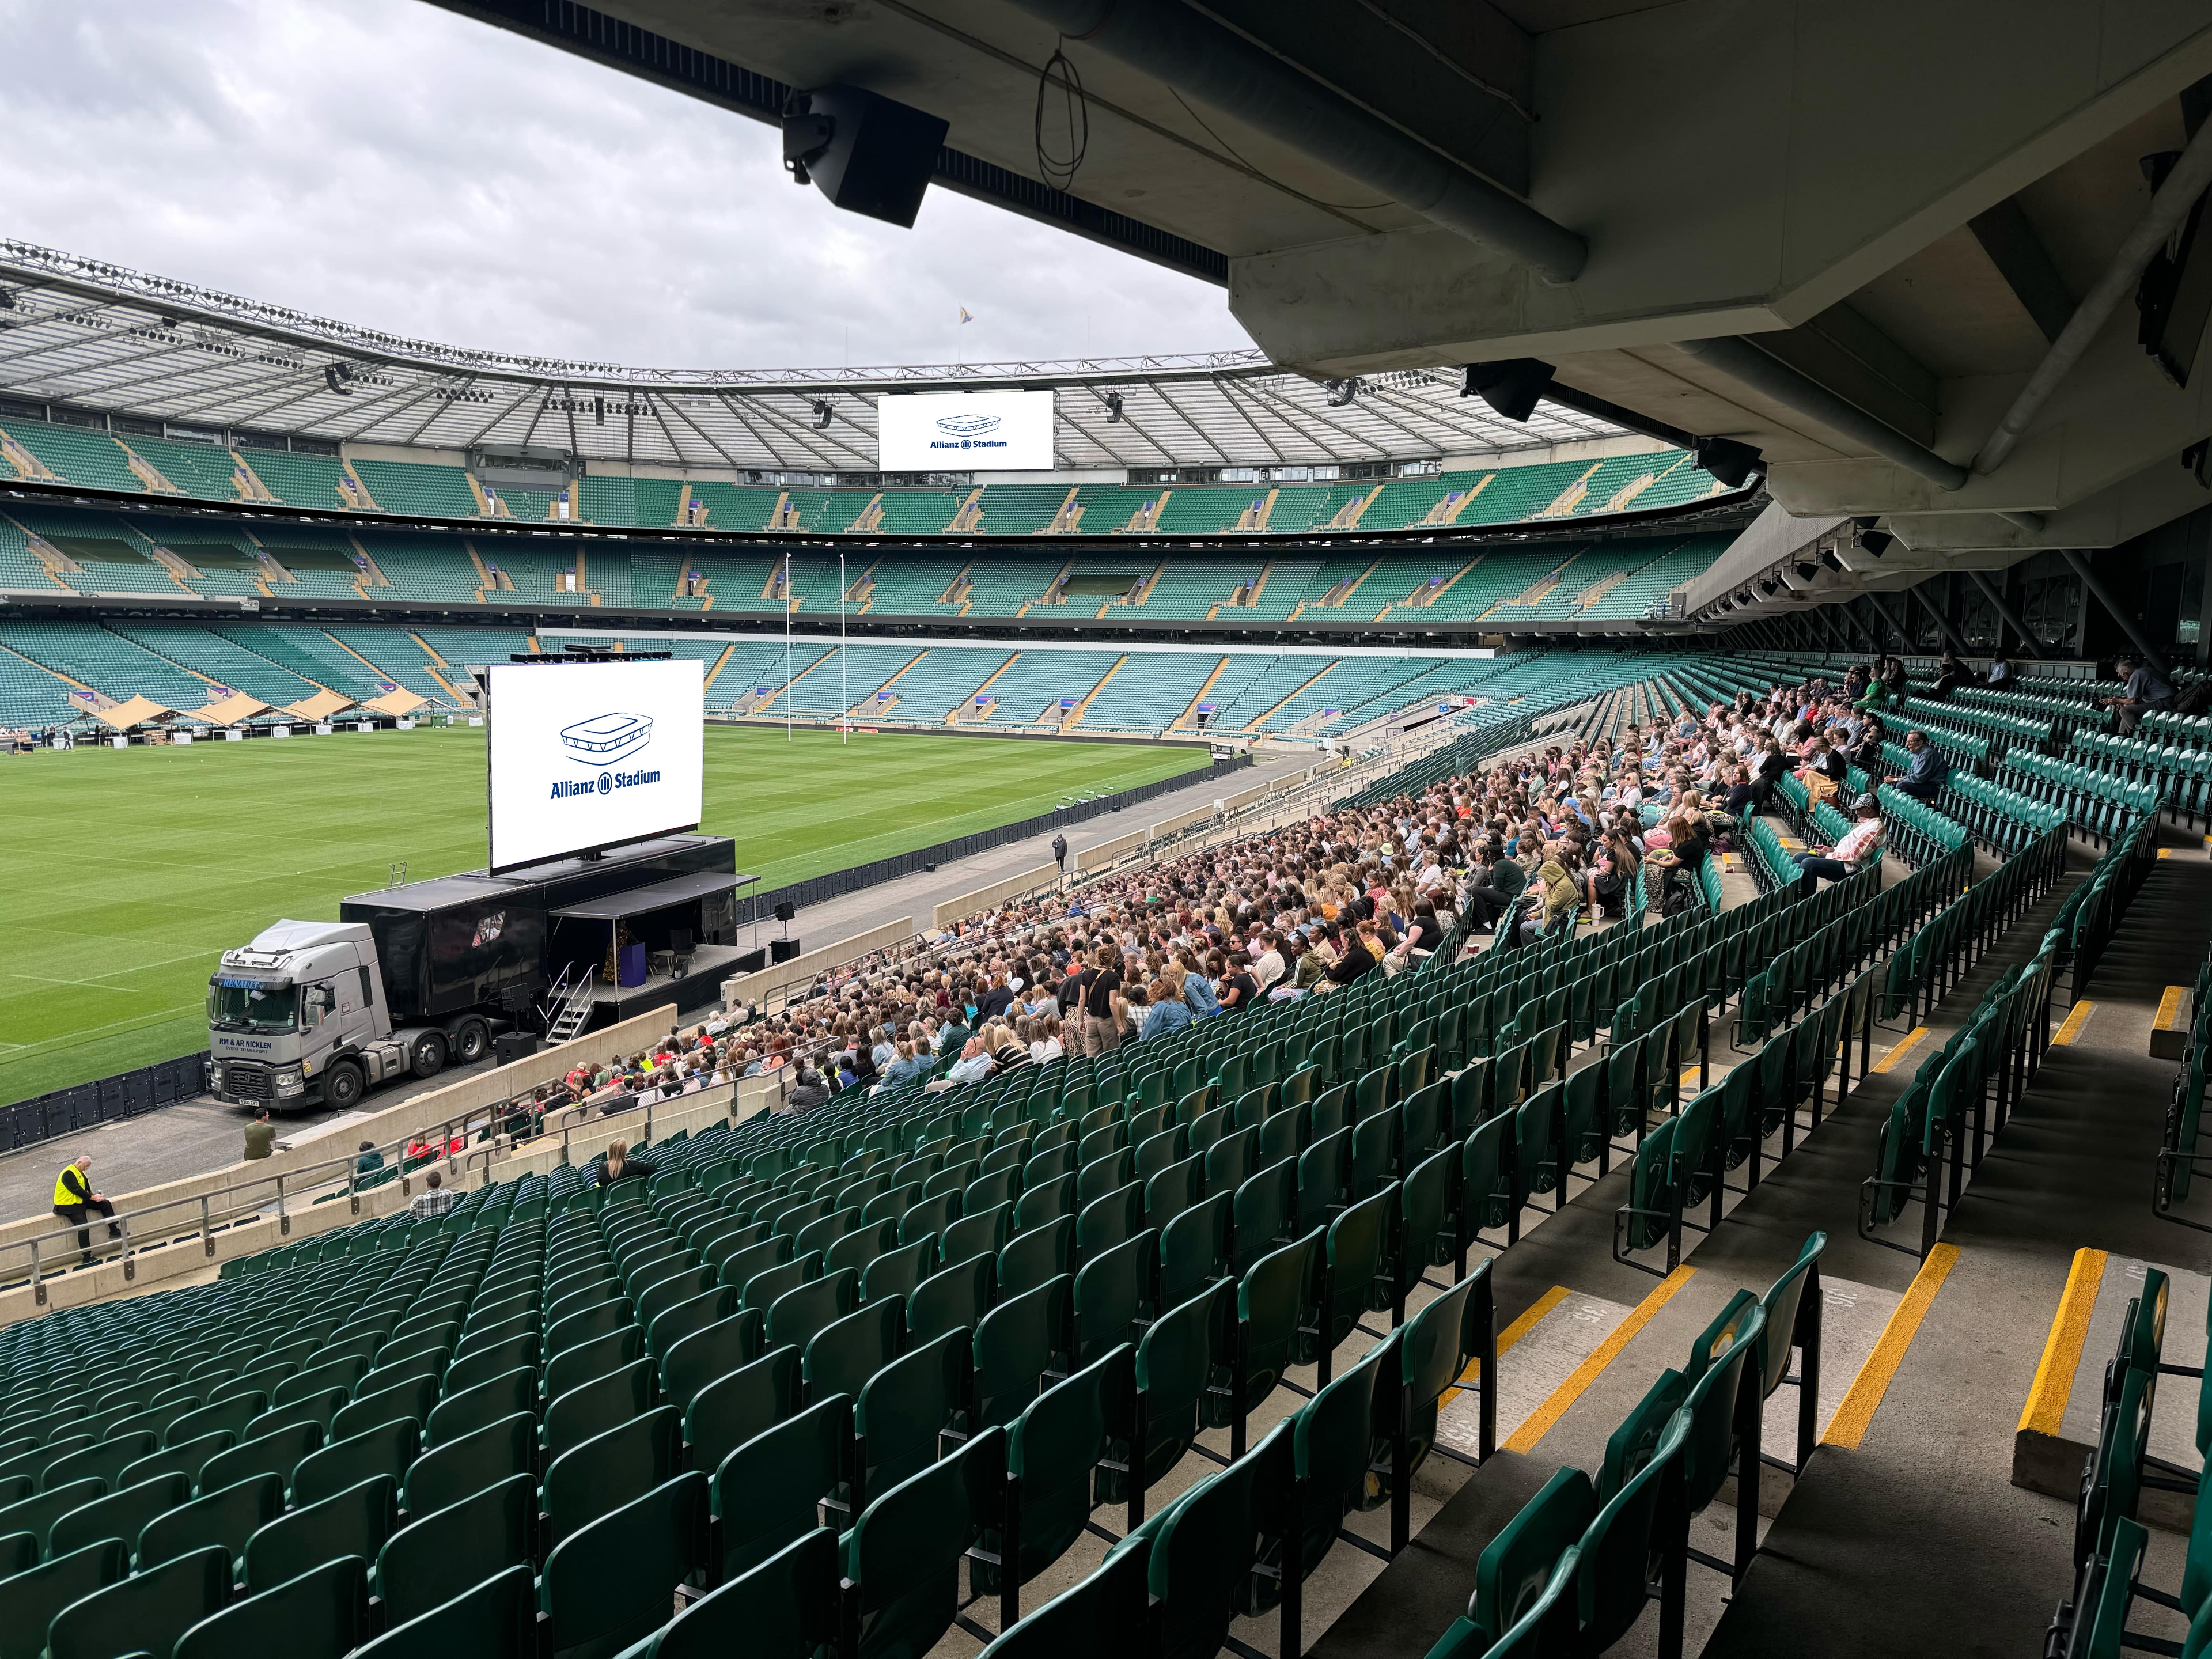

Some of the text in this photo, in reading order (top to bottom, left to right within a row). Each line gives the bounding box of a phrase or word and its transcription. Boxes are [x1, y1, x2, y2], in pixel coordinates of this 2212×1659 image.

[550, 769, 660, 800] Allianz Stadium
[222, 979, 259, 990] RENAULT
[245, 1040, 272, 1049] NICKLEN
